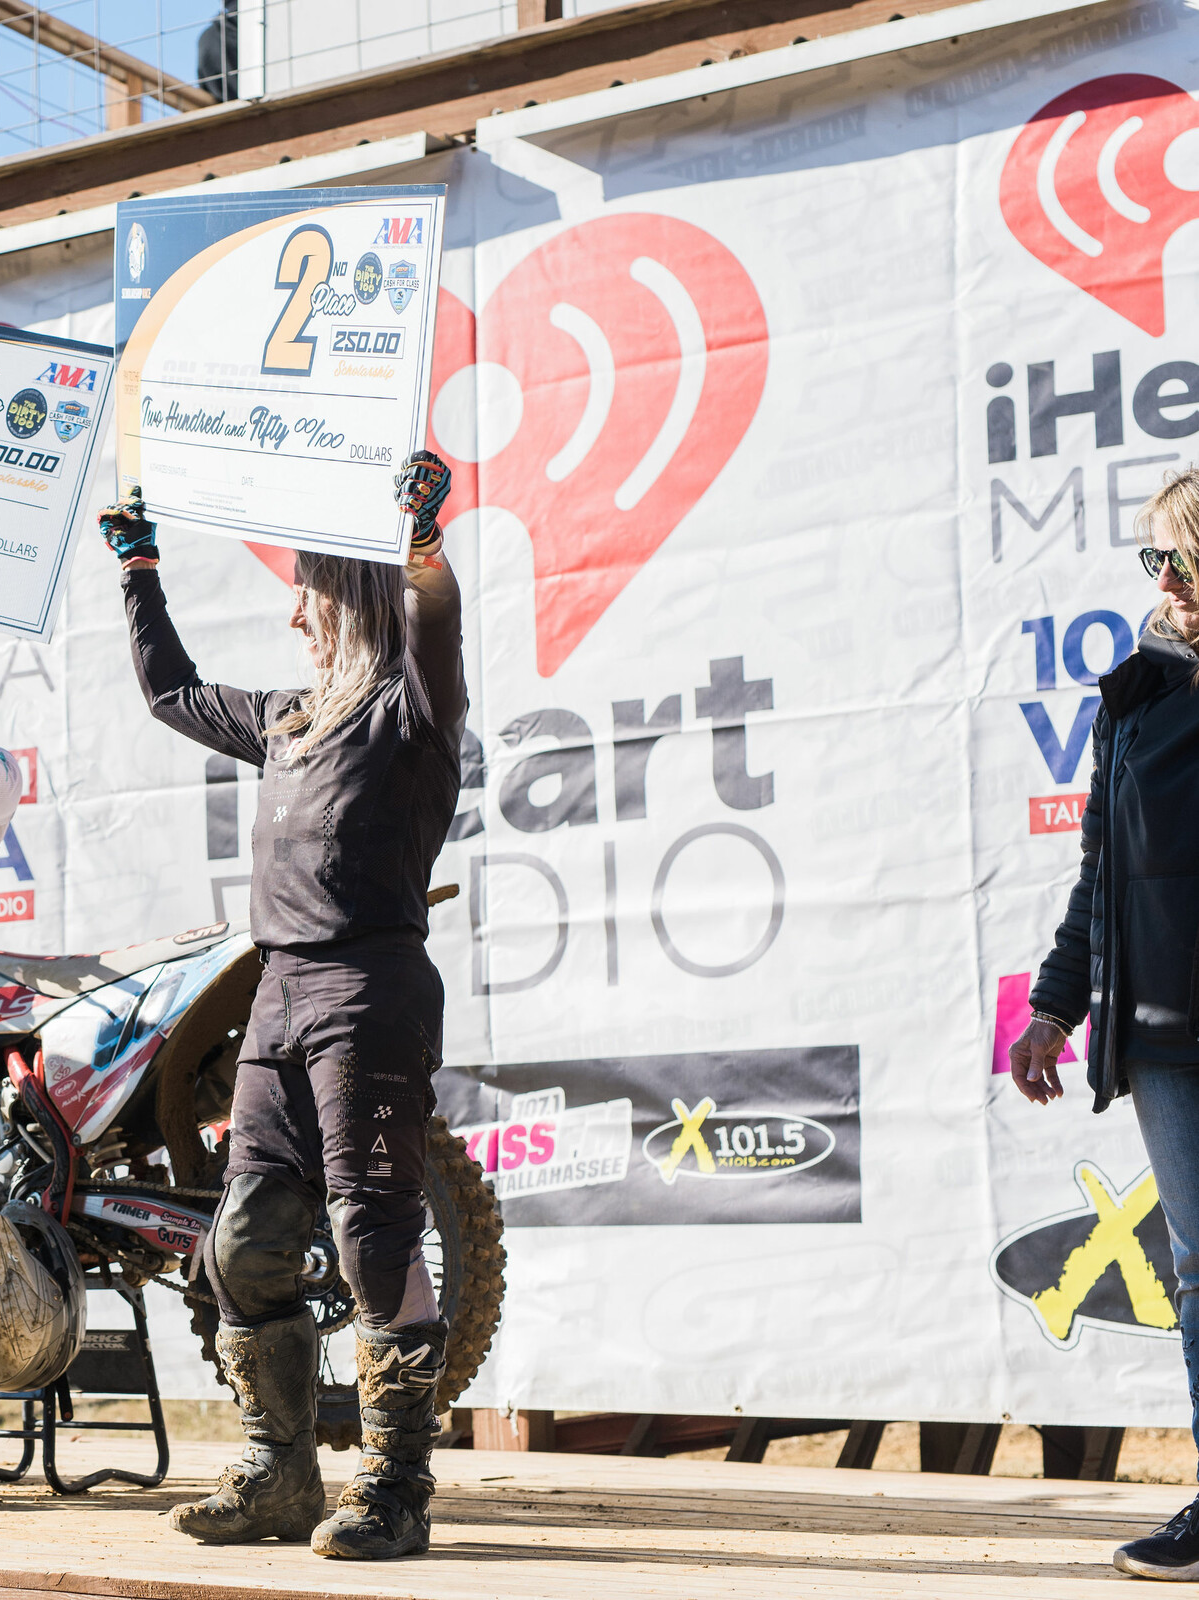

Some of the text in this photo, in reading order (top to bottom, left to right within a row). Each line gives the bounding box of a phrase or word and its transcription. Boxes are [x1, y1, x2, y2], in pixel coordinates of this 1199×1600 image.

[373, 218, 423, 244] AMA
[355, 269, 382, 286] DIRTY
[261, 224, 348, 378] 2 ND
[311, 282, 356, 318] Place
[332, 330, 401, 354] 250.00
[34, 361, 97, 391] AMA
[334, 359, 395, 380] Scholarship
[9, 402, 45, 423] DIRTY
[141, 395, 163, 429] Two
[163, 400, 224, 434] Hundred
[224, 420, 246, 438] and
[249, 405, 289, 449] Fifty
[350, 446, 392, 462] DOLLARS
[516, 1094, 560, 1120] 107.1
[714, 1122, 806, 1158] 101.5
[112, 1201, 151, 1221] TAMER
[160, 1211, 189, 1227] Sample
[157, 1226, 193, 1249] GUTS
